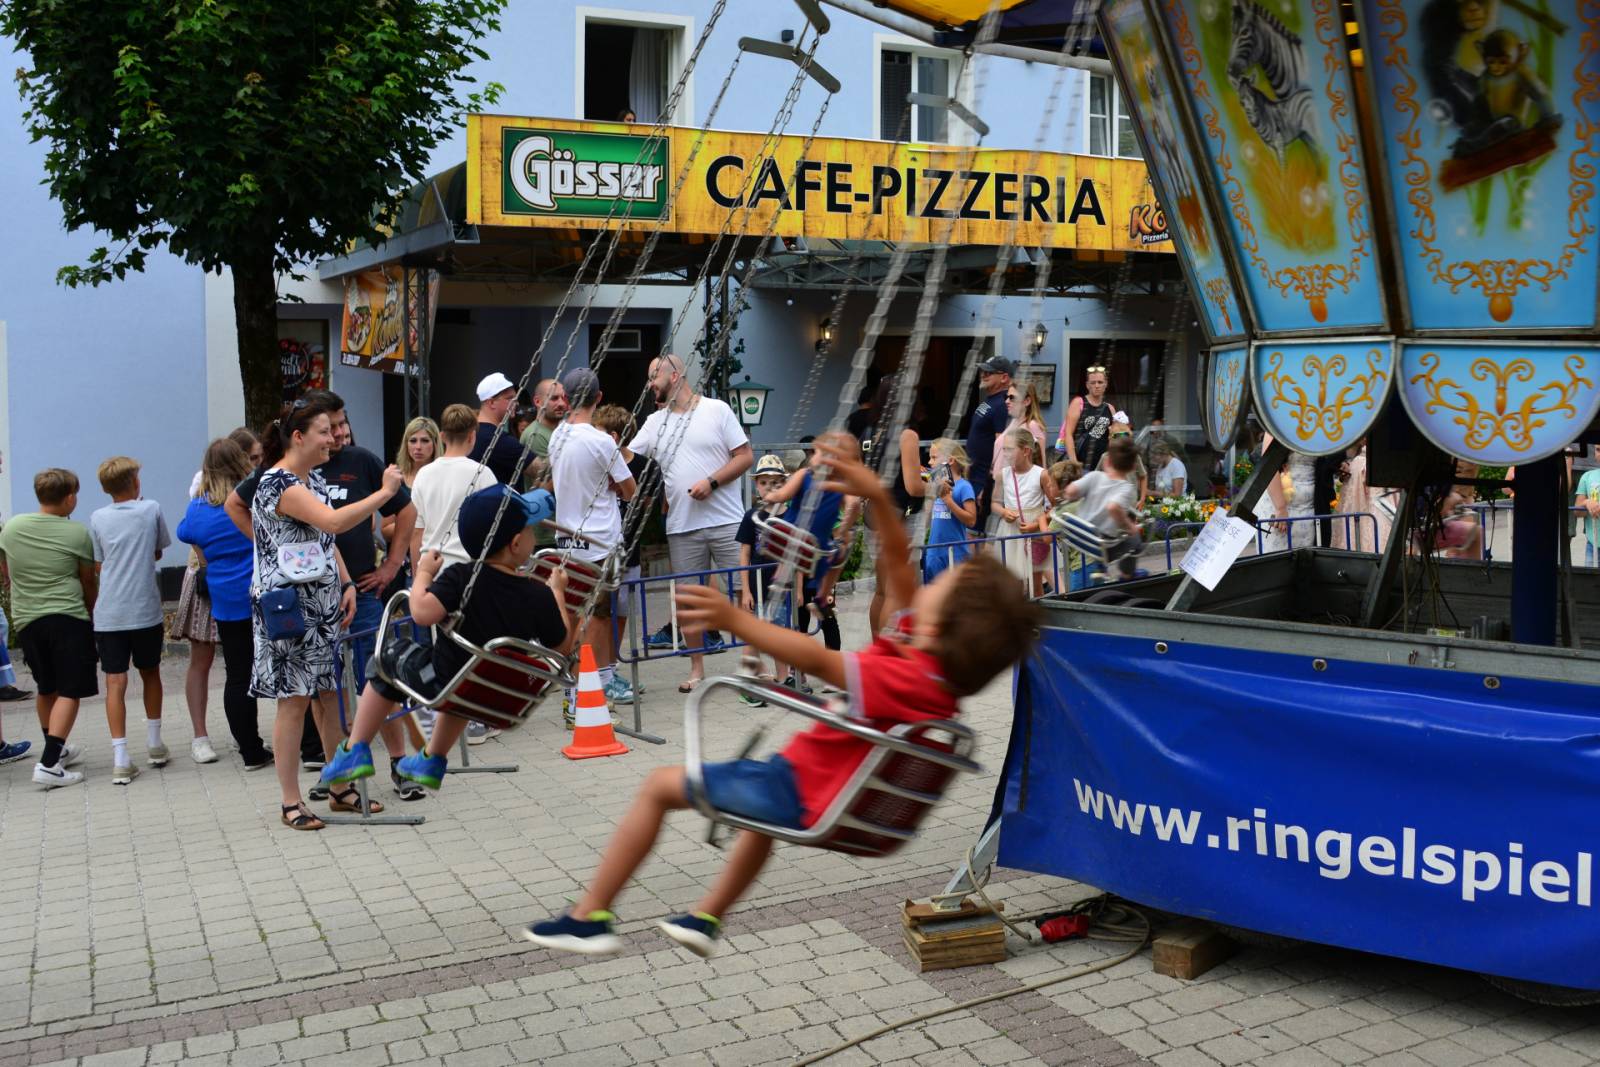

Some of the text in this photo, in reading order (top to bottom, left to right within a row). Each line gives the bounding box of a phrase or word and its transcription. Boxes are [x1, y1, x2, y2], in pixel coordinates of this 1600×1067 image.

[510, 136, 660, 207] Gösser
[1142, 231, 1169, 242] Pizzeria
[1073, 778, 1592, 907] www.ringelspiel
